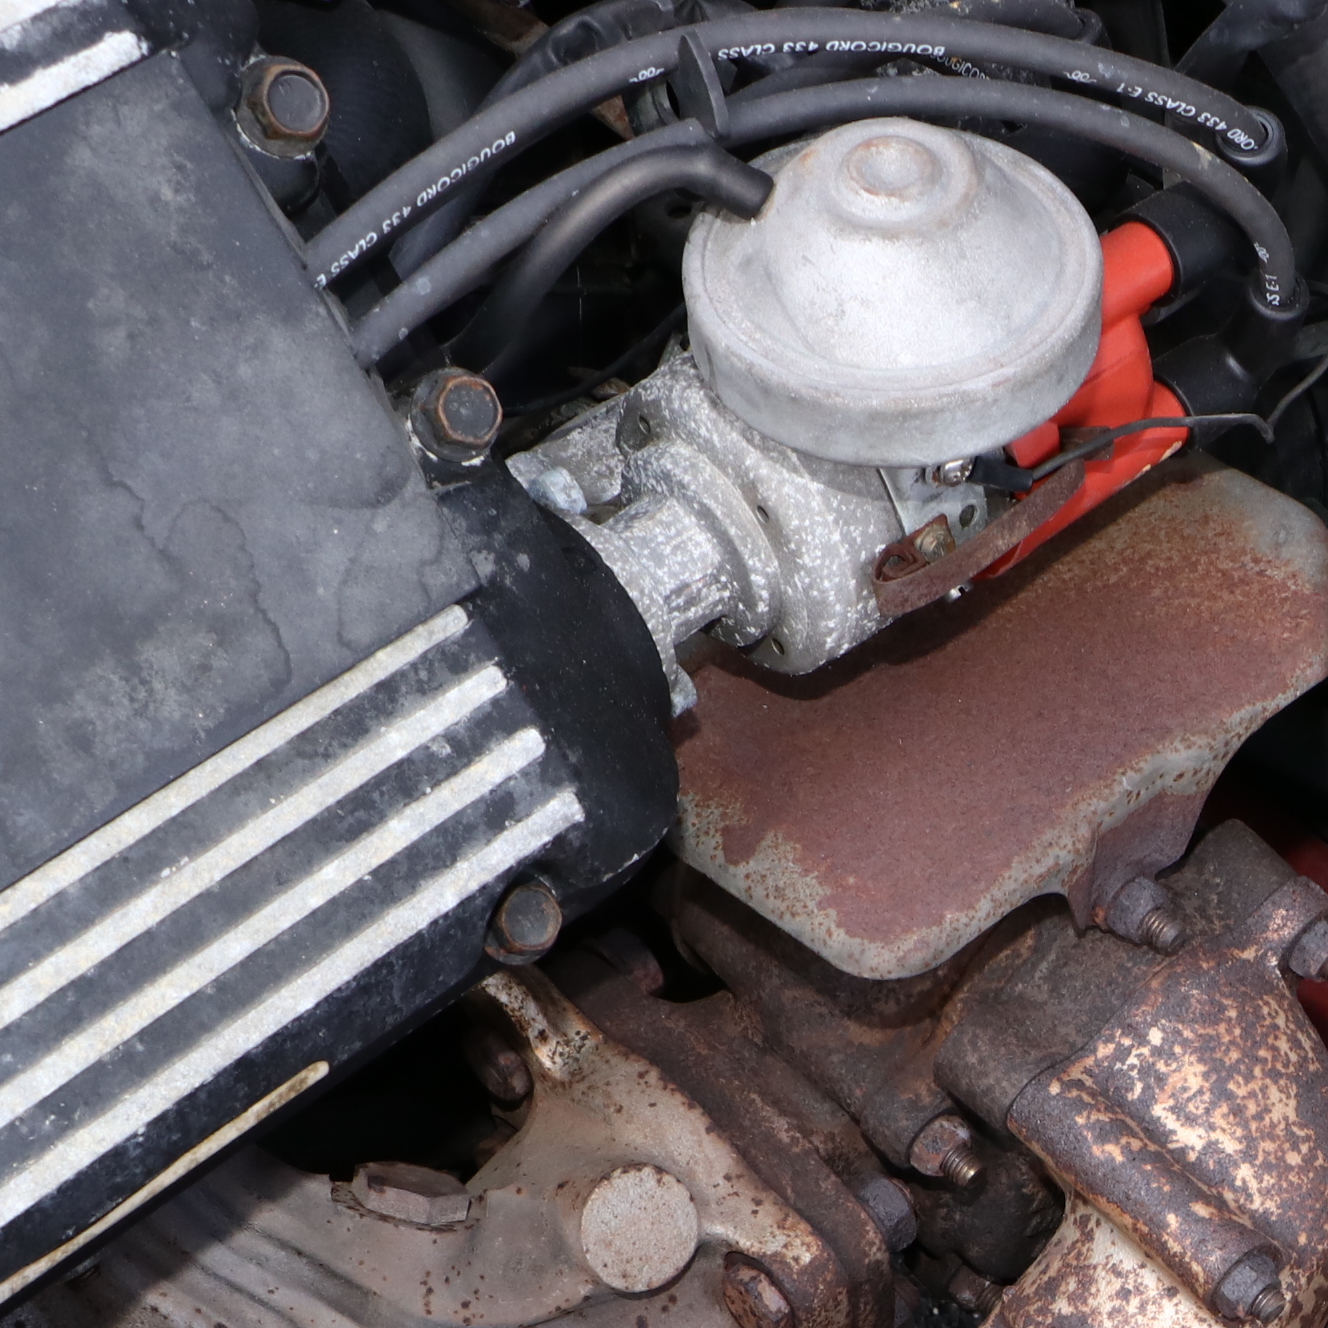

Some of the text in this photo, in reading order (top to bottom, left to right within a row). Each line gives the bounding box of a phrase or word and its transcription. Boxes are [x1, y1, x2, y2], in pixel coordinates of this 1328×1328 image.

[717, 40, 946, 61] BOUGICORD 433 CLASS
[1145, 93, 1195, 117] CLASS
[1198, 113, 1227, 132] 433
[416, 130, 516, 208] BOUGICORD
[381, 205, 412, 235] 433
[330, 230, 378, 278] CLASS
